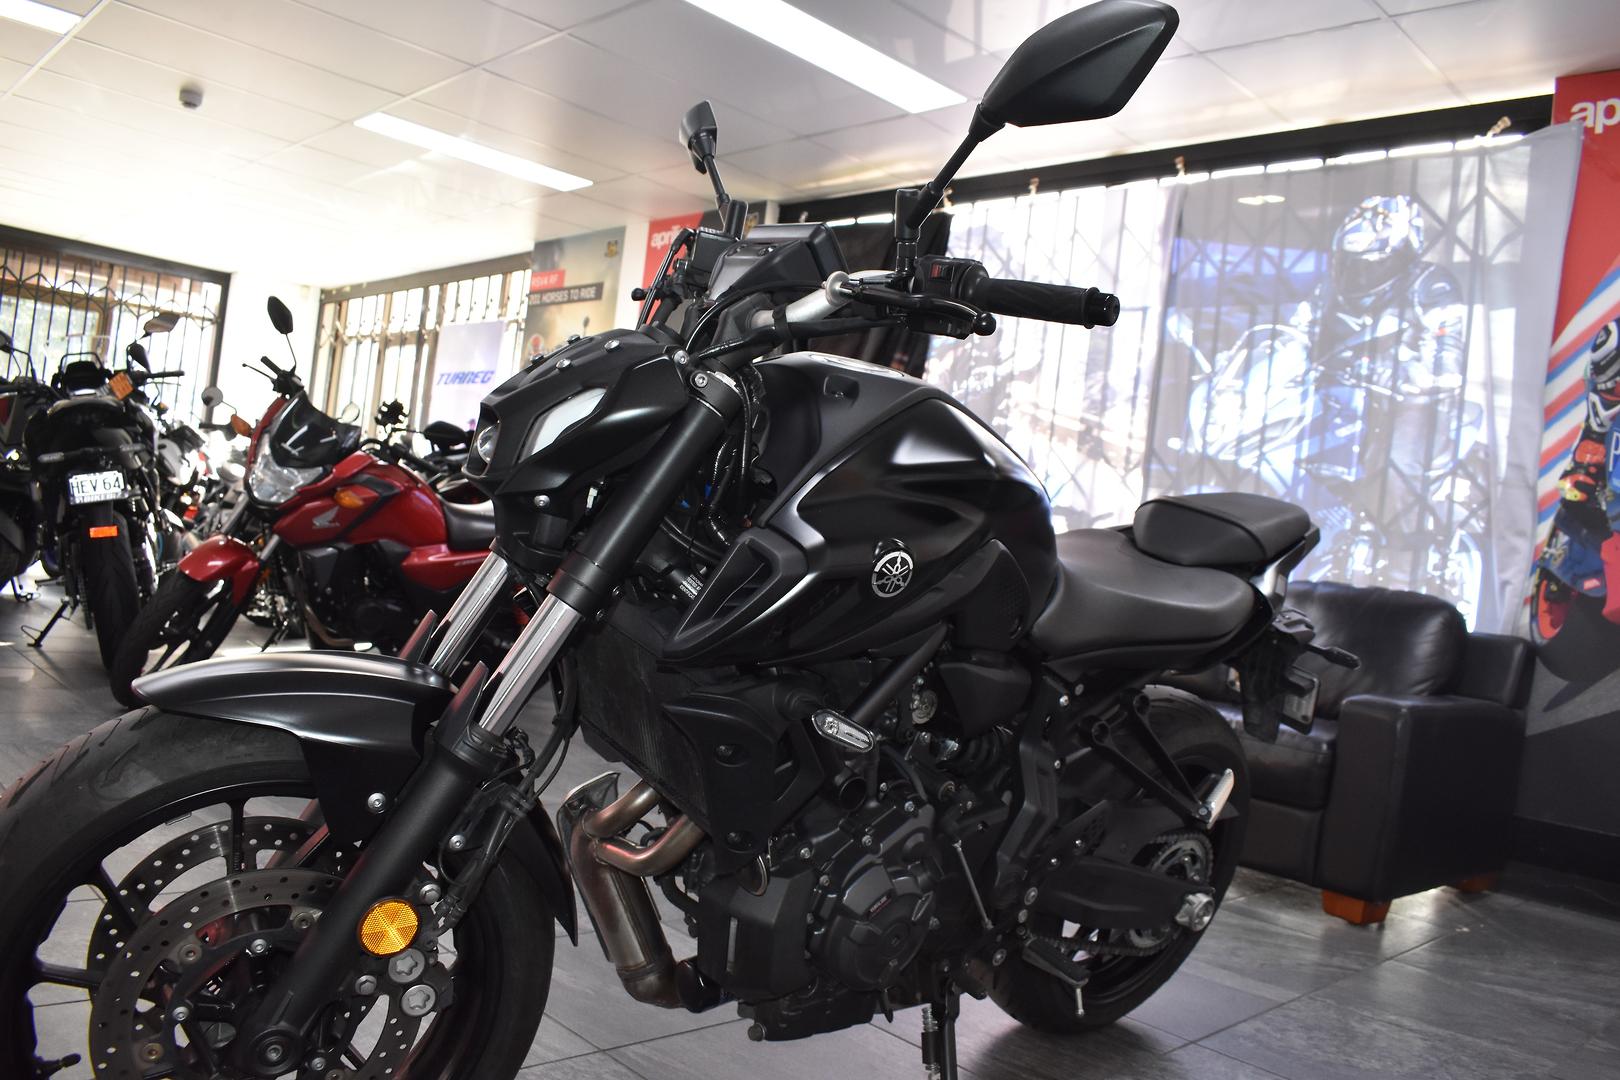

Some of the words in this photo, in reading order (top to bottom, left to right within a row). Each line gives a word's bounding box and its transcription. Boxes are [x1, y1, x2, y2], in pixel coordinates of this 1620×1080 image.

[542, 290, 569, 303] HORSES
[570, 288, 579, 300] TO
[580, 286, 597, 299] RIDE
